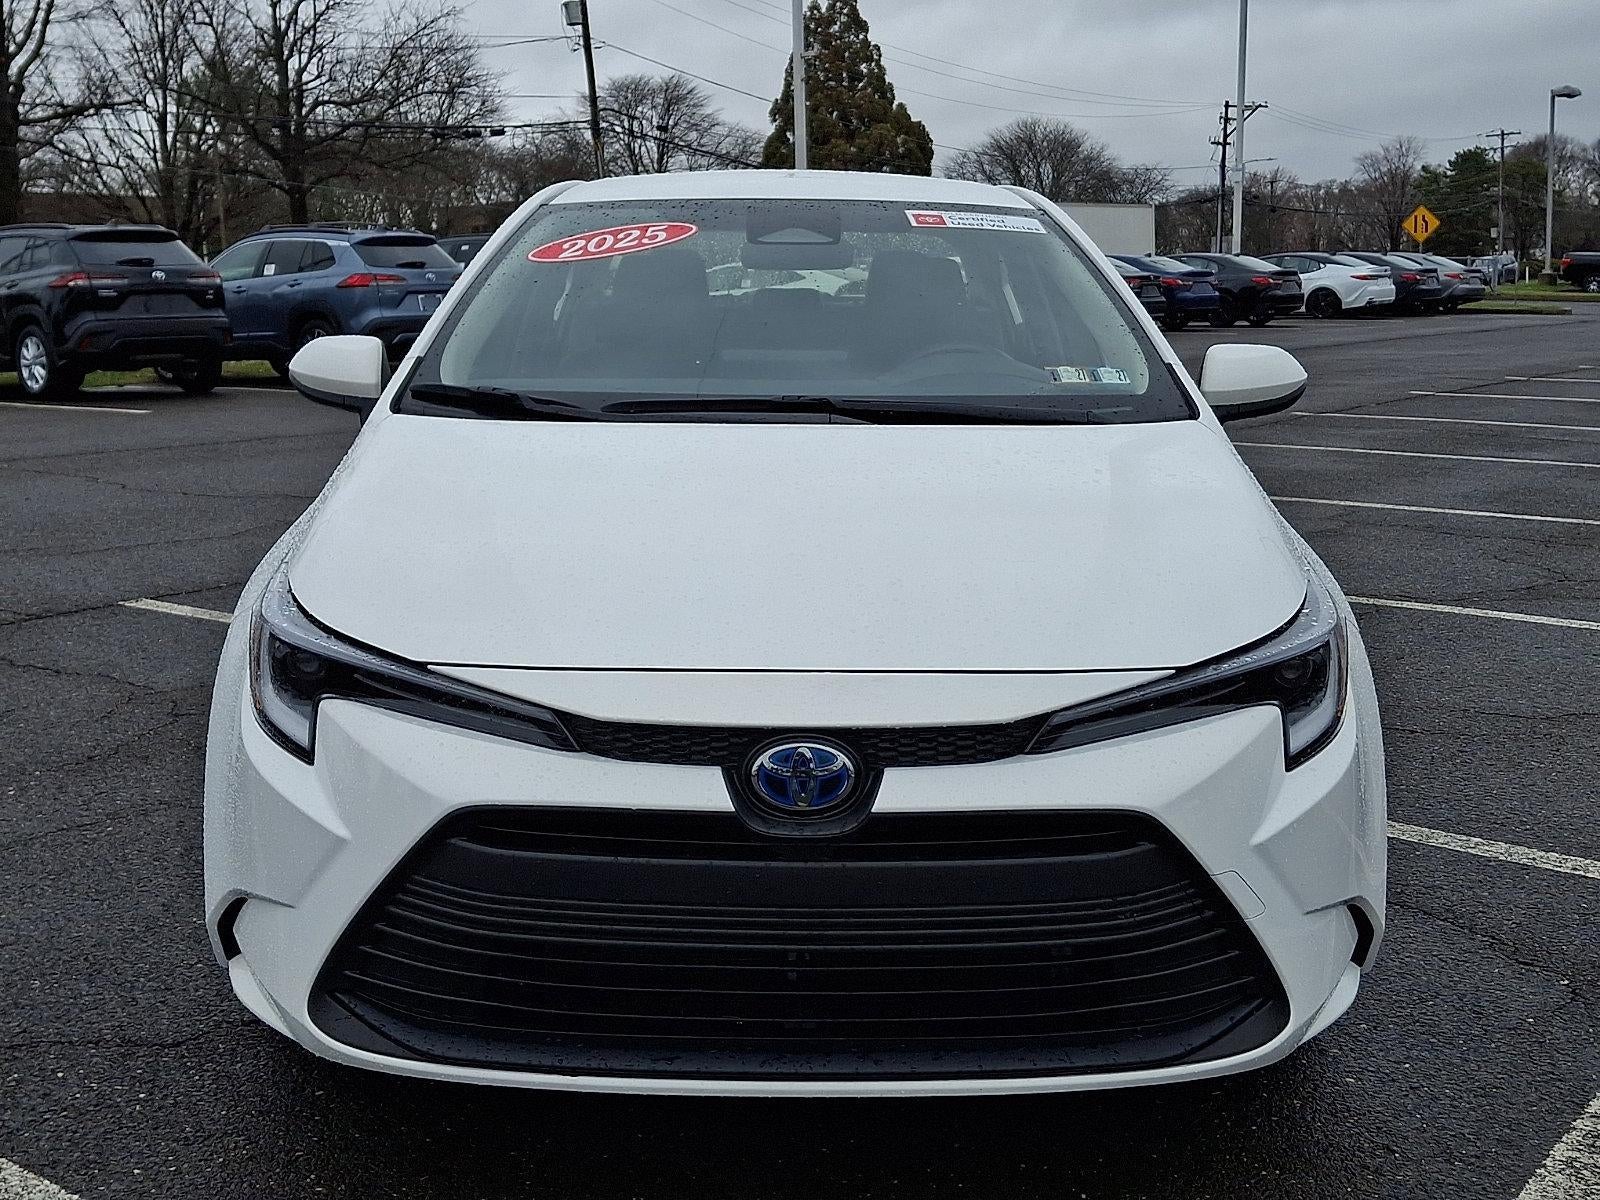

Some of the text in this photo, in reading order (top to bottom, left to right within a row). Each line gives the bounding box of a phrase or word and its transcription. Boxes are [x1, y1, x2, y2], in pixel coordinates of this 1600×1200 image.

[948, 214, 1006, 224] Certified
[951, 220, 1041, 232] Used Vehicles
[558, 225, 669, 259] 2025
